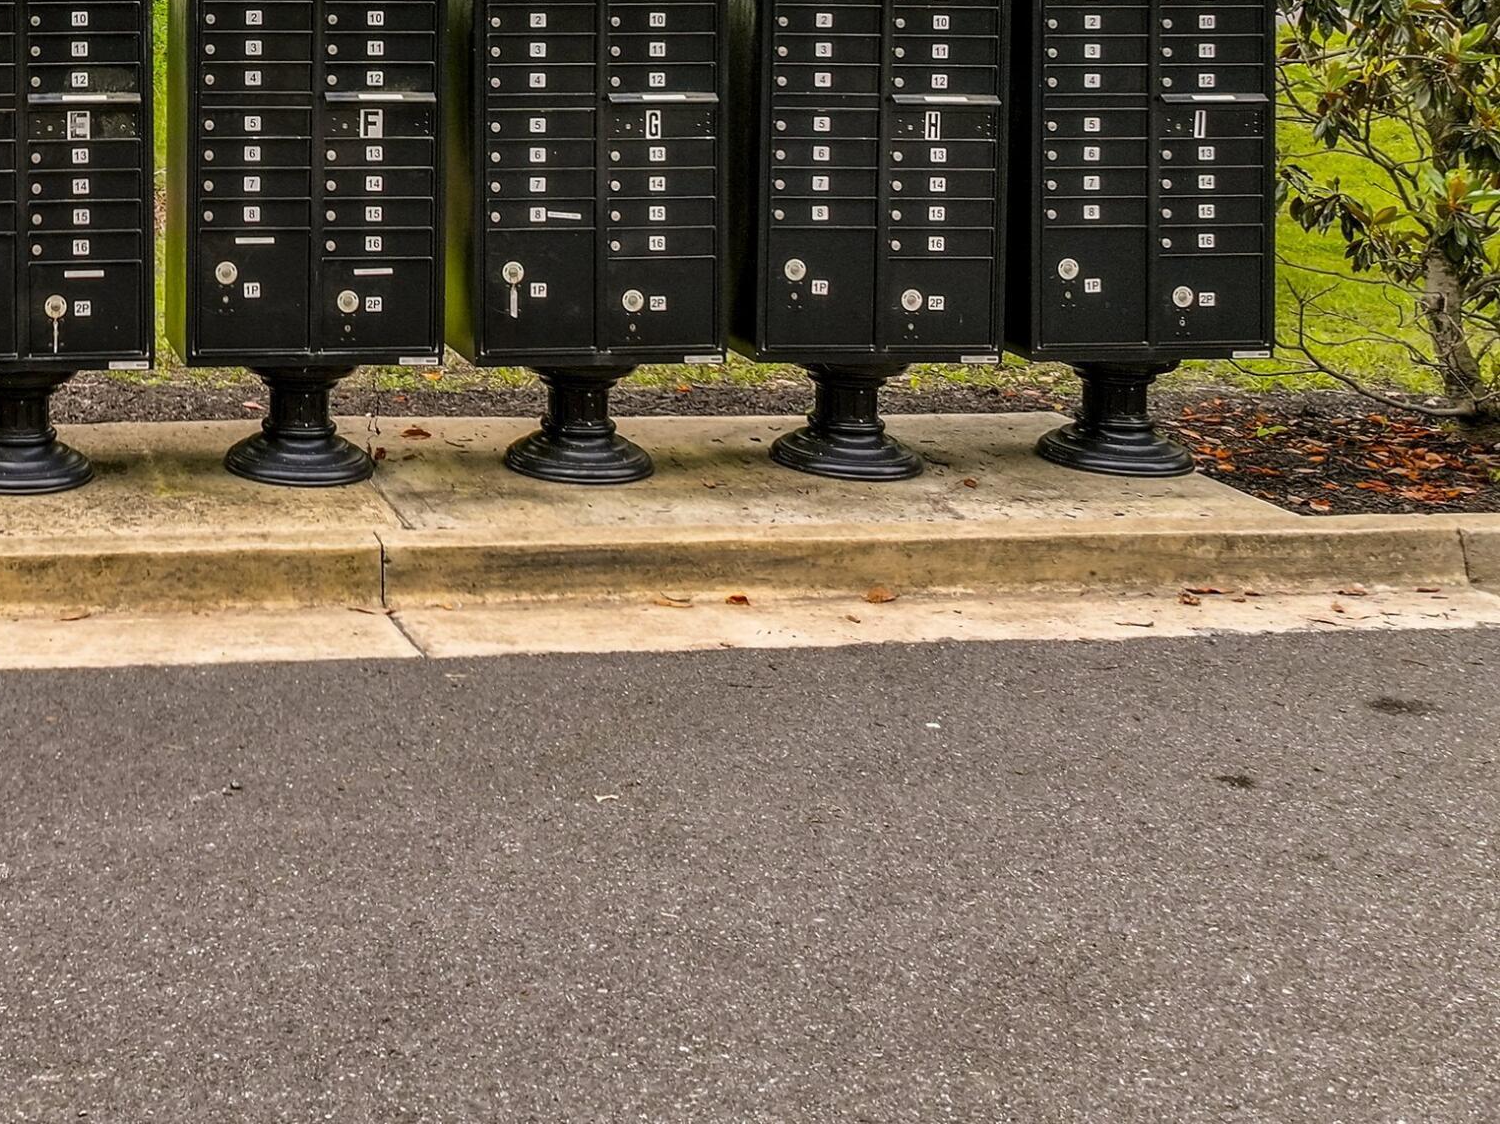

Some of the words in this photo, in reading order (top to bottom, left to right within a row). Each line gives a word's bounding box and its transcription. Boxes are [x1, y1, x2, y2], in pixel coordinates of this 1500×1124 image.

[73, 13, 87, 24] 10
[250, 12, 258, 23] 2
[369, 13, 382, 24] 10
[534, 15, 542, 26] 2
[651, 14, 664, 25] 10
[935, 17, 948, 28] 10
[1089, 17, 1097, 27] 2
[1201, 17, 1213, 27] 10
[74, 43, 86, 54] 11
[250, 42, 258, 53] 3
[370, 43, 382, 53] 11
[534, 44, 542, 55] 3
[652, 44, 663, 55] 11
[820, 44, 828, 55] 3
[934, 46, 946, 56] 11
[1089, 46, 1097, 56] 3
[1201, 46, 1212, 56] 11
[74, 74, 86, 85] 12
[250, 73, 257, 82] 4
[369, 73, 382, 84] 12
[534, 75, 542, 84] 4
[651, 74, 664, 85] 12
[819, 75, 827, 84] 4
[934, 76, 946, 86] 12
[1088, 76, 1096, 85] 4
[1200, 75, 1213, 85] 12
[69, 112, 88, 139] E
[250, 118, 257, 128] 5
[363, 110, 380, 137] F
[534, 120, 542, 130] 5
[648, 112, 660, 138] G
[818, 118, 826, 129] 5
[927, 112, 939, 139] H
[1088, 119, 1096, 130] 5
[74, 150, 87, 161] 13
[248, 148, 256, 158] 6
[368, 148, 381, 158] 13
[651, 149, 664, 159] 13
[933, 150, 945, 160] 13
[1088, 148, 1096, 158] 6
[1200, 148, 1212, 158] 13
[74, 181, 87, 192] 14
[248, 179, 256, 189] 7
[368, 178, 380, 189] 14
[534, 179, 542, 189] 7
[651, 179, 664, 188] 14
[816, 178, 825, 188] 7
[932, 179, 944, 189] 14
[1088, 178, 1096, 188] 7
[1200, 177, 1212, 187] 14
[248, 209, 256, 219] 8
[368, 208, 380, 219] 15
[651, 208, 664, 218] 15
[816, 208, 824, 218] 8
[931, 208, 943, 219] 15
[1200, 206, 1213, 216] 15
[76, 211, 88, 222] 15
[368, 238, 380, 249] 16
[651, 238, 664, 248] 16
[930, 238, 943, 249] 16
[1200, 235, 1213, 246] 16
[75, 242, 88, 252] 16
[246, 285, 259, 296] 1P
[532, 285, 546, 295] 1P
[814, 282, 827, 292] 1P
[1086, 280, 1100, 291] 1P
[367, 299, 380, 309] 2P
[651, 298, 665, 308] 2P
[930, 298, 943, 308] 2P
[1200, 294, 1214, 304] 2P
[76, 303, 90, 314] 2P
